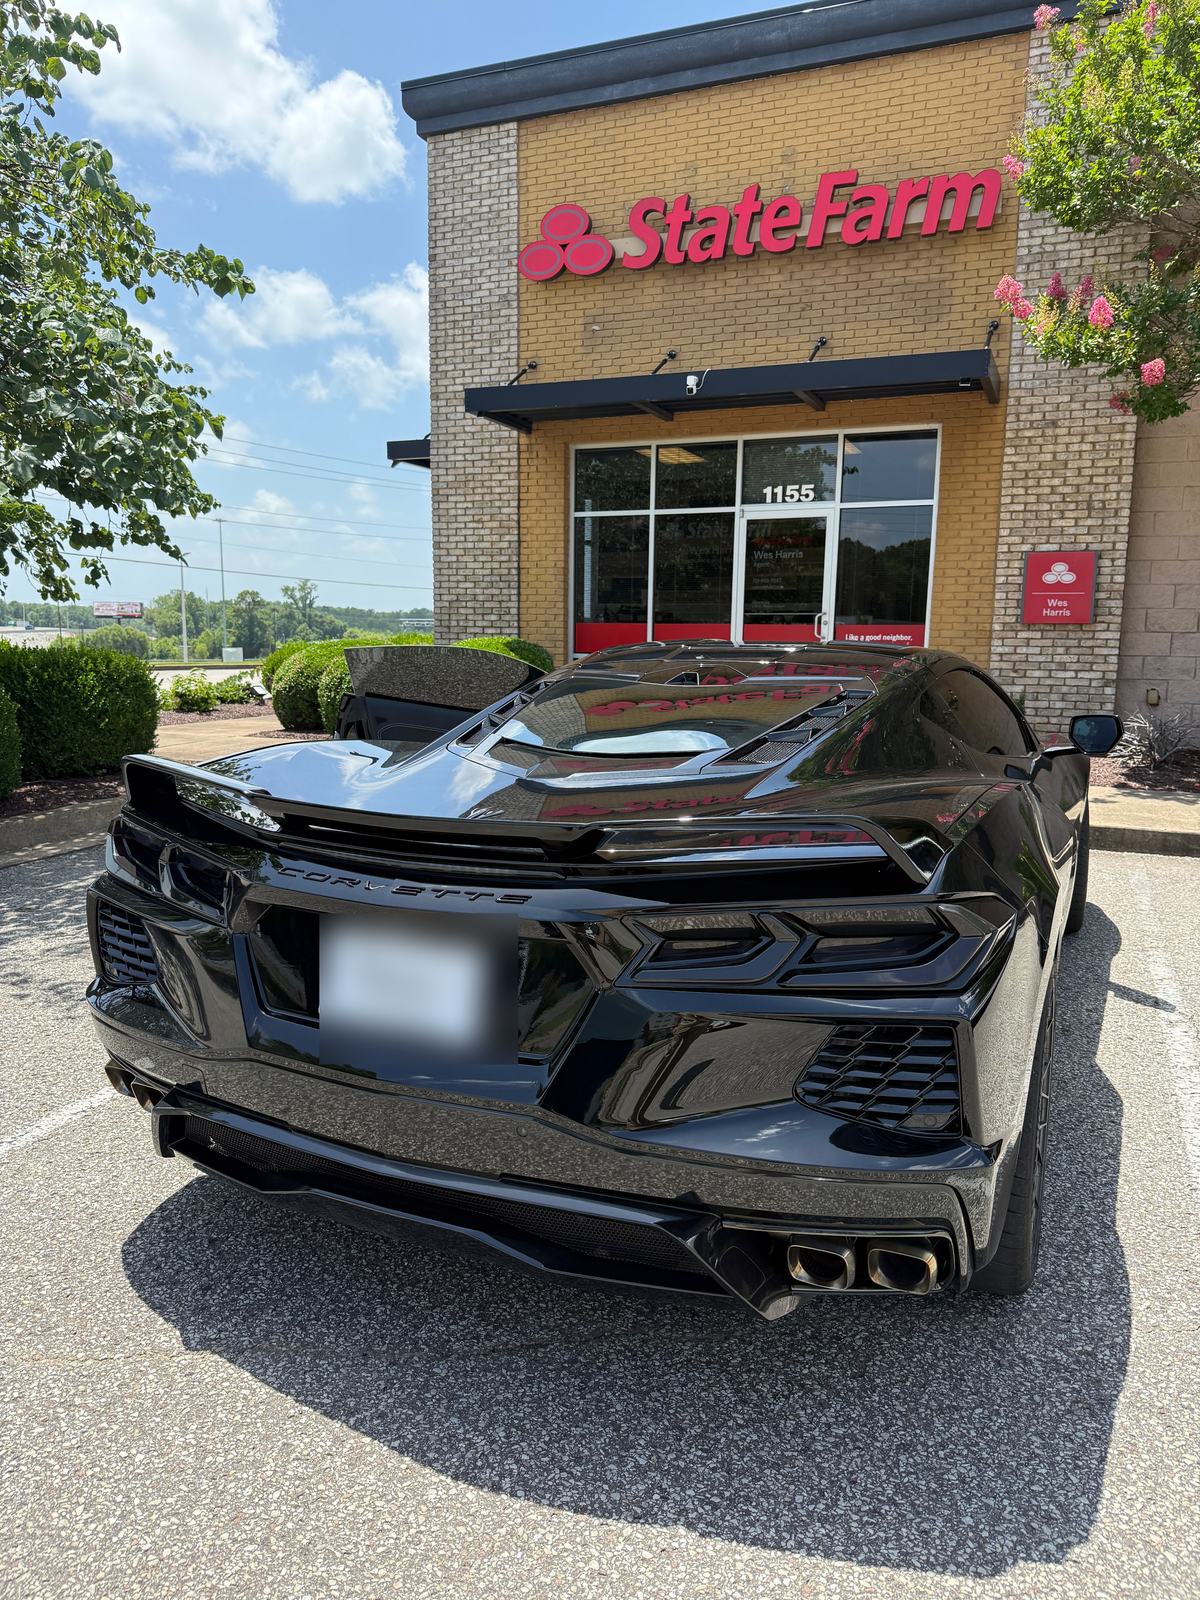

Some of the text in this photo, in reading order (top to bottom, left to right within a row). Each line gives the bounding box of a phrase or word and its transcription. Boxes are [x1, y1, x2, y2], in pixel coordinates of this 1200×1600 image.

[763, 484, 815, 503] 1155
[753, 550, 774, 560] Wes
[1042, 598, 1071, 617] Wes Harris
[845, 633, 859, 641] Like
[865, 633, 882, 642] good
[278, 866, 532, 904] CORVETTE
